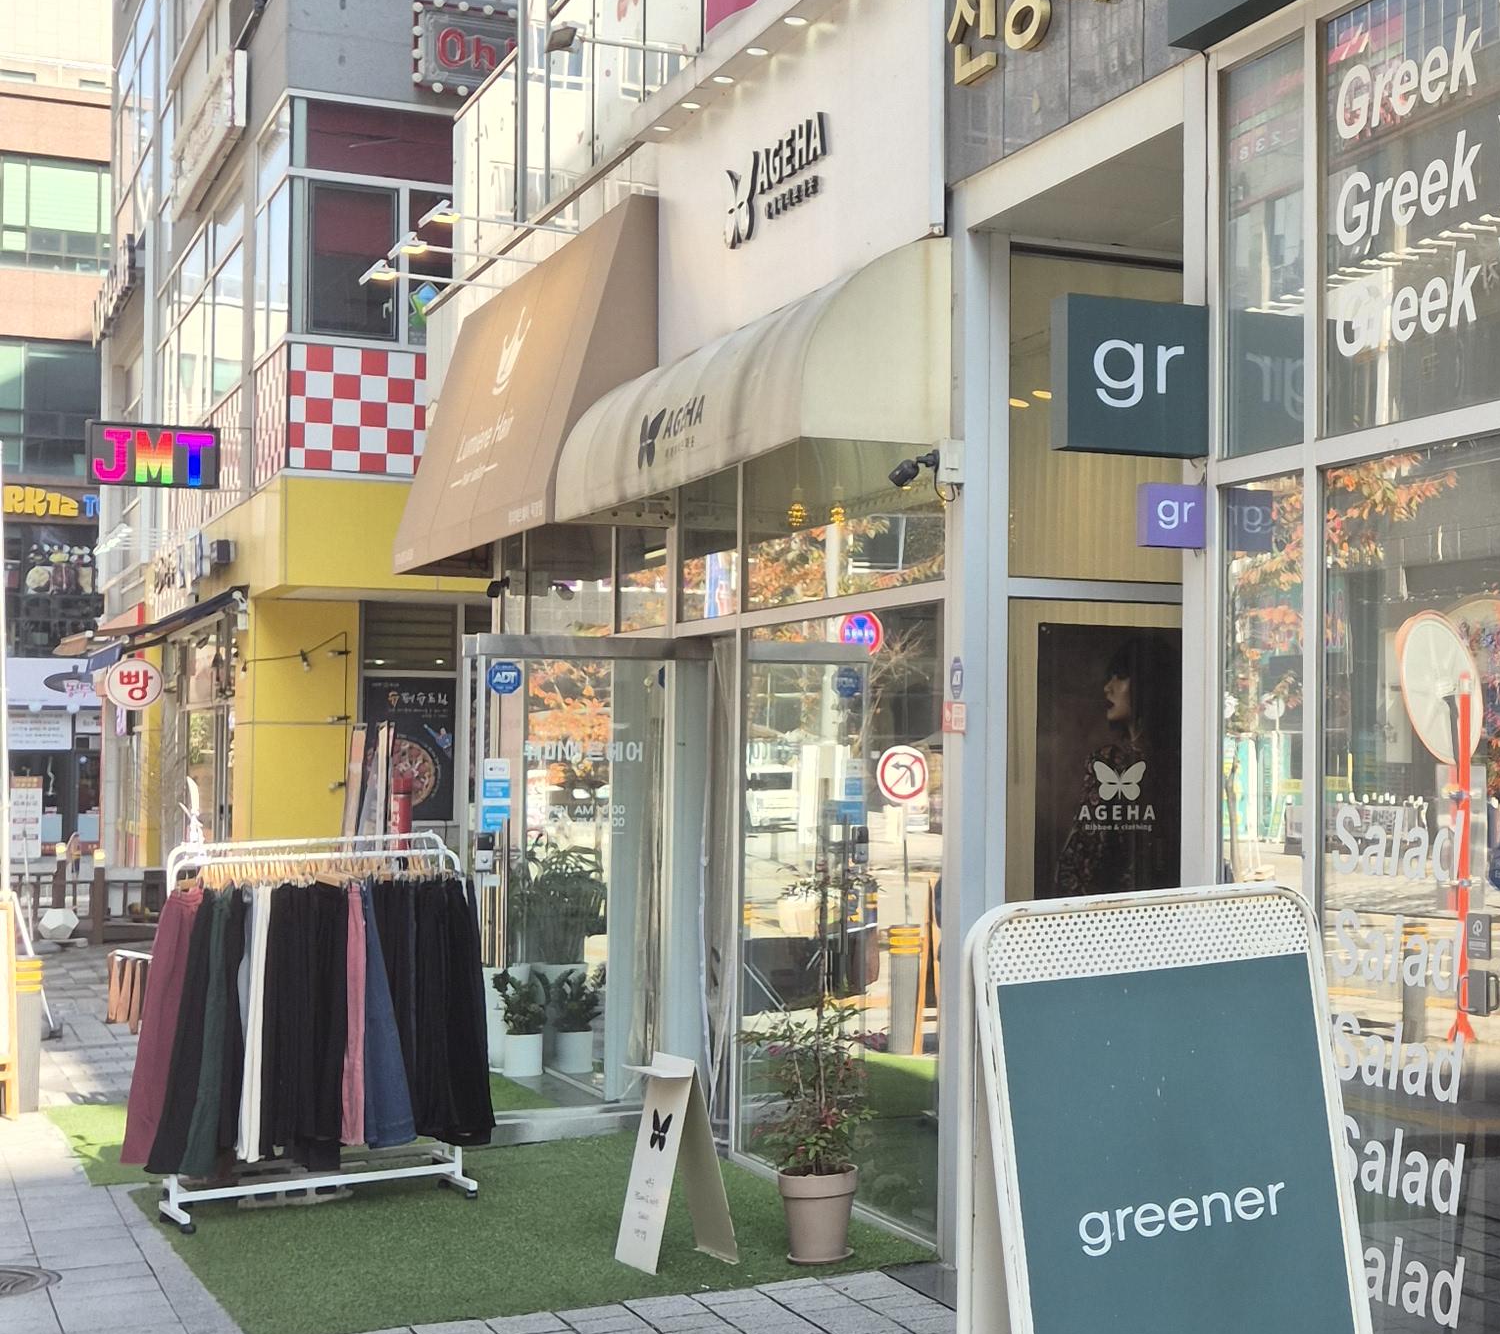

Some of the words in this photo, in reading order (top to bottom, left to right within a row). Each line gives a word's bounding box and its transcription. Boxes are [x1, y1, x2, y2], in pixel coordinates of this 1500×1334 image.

[1336, 16, 1483, 140] Greek
[757, 111, 826, 196] AGEHA
[1336, 129, 1483, 247] Greek
[1336, 249, 1483, 357] Greek
[1093, 339, 1185, 408] gr
[93, 428, 215, 487] JMT
[662, 395, 706, 441] AGEHA
[1156, 498, 1196, 530] gr
[119, 669, 153, 701] 빵
[493, 671, 517, 684] ADT
[1078, 804, 1156, 821] AGEHA
[1333, 801, 1465, 884] Salad
[1333, 908, 1464, 994] Salad
[1333, 1010, 1464, 1104] Salad
[1343, 1114, 1465, 1216] Salad
[1078, 1179, 1285, 1258] greener
[1362, 1237, 1466, 1329] alad
